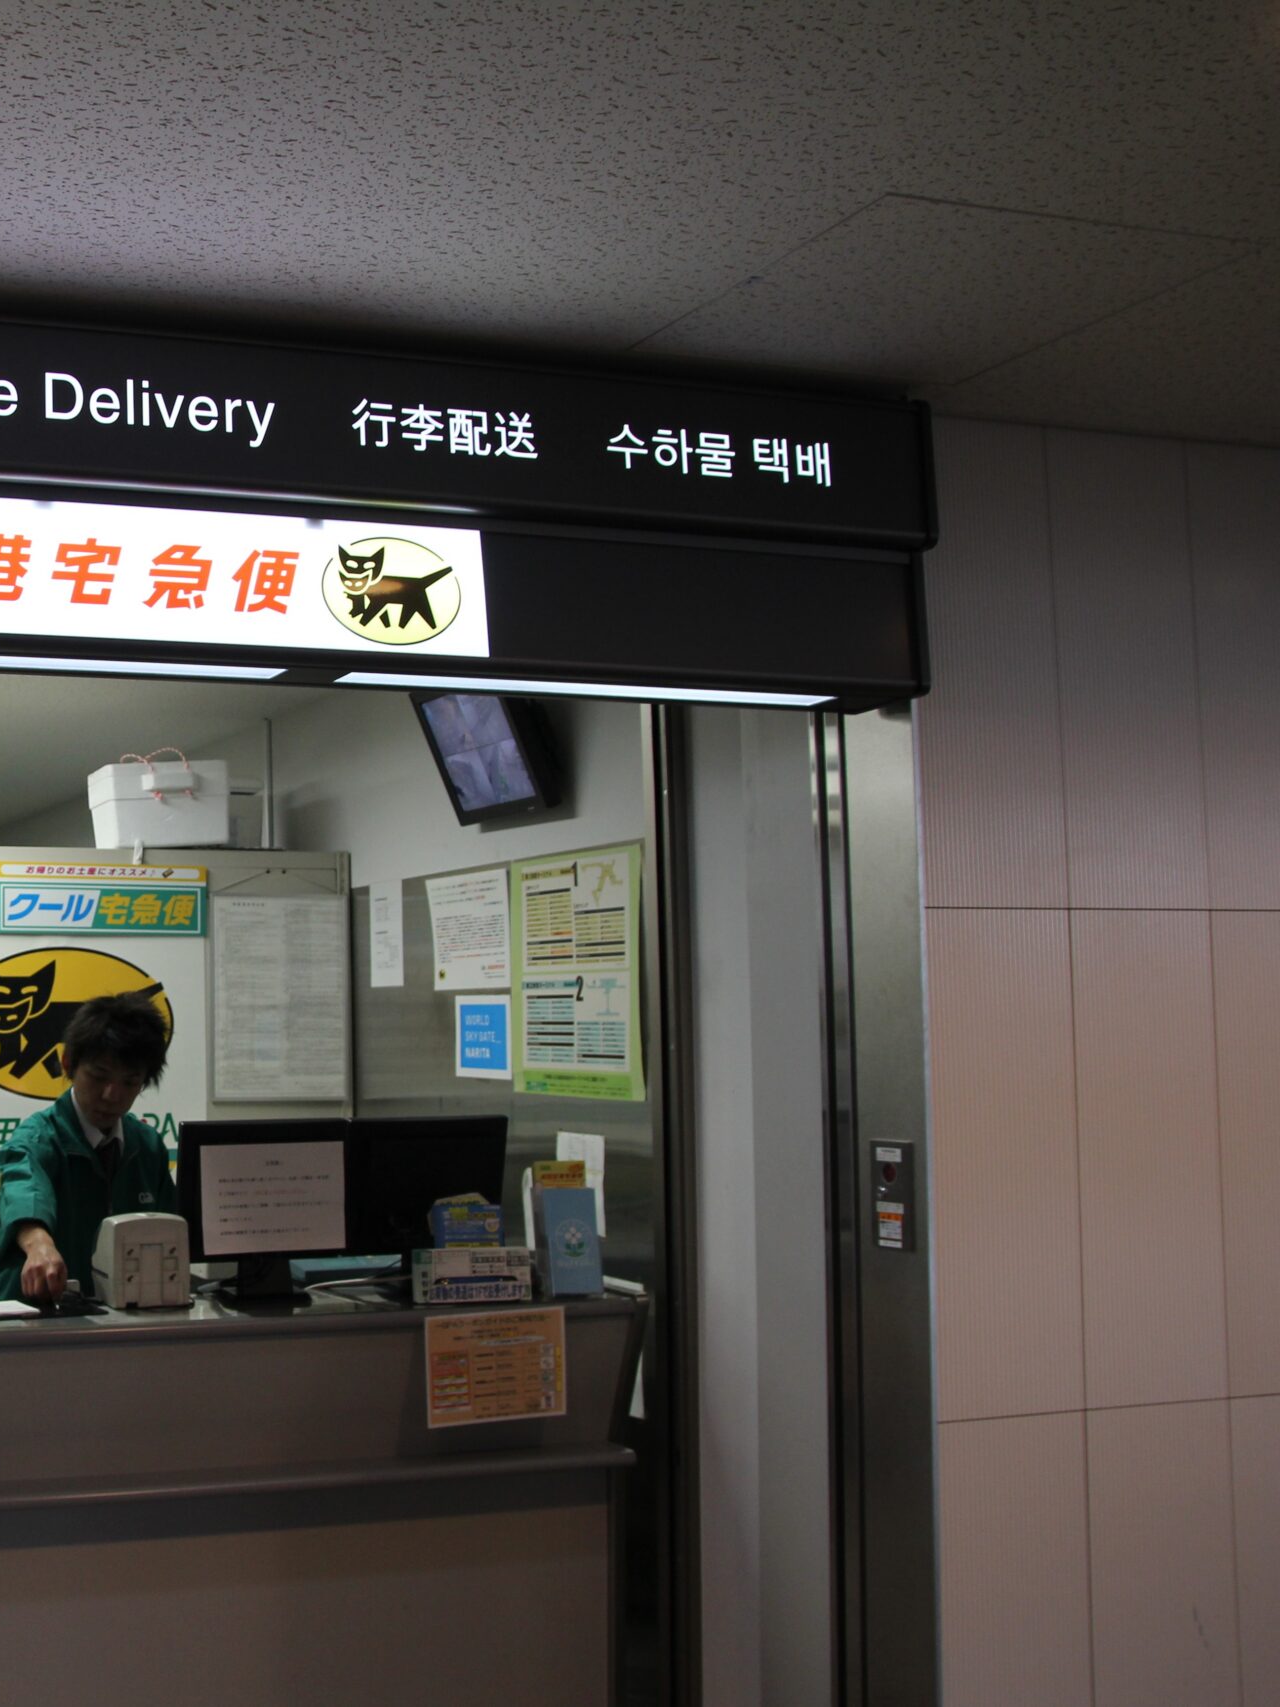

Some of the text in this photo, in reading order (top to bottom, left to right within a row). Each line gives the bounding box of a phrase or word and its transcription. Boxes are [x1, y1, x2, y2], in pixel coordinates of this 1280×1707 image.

[44, 372, 275, 447] Delivery
[351, 398, 539, 460] 行李配送
[607, 424, 832, 487] 수하물 택배
[8, 892, 197, 926] クール宅急便
[575, 975, 584, 1002] 2
[464, 1015, 490, 1026] WORLD
[464, 1047, 491, 1059] NARITA
